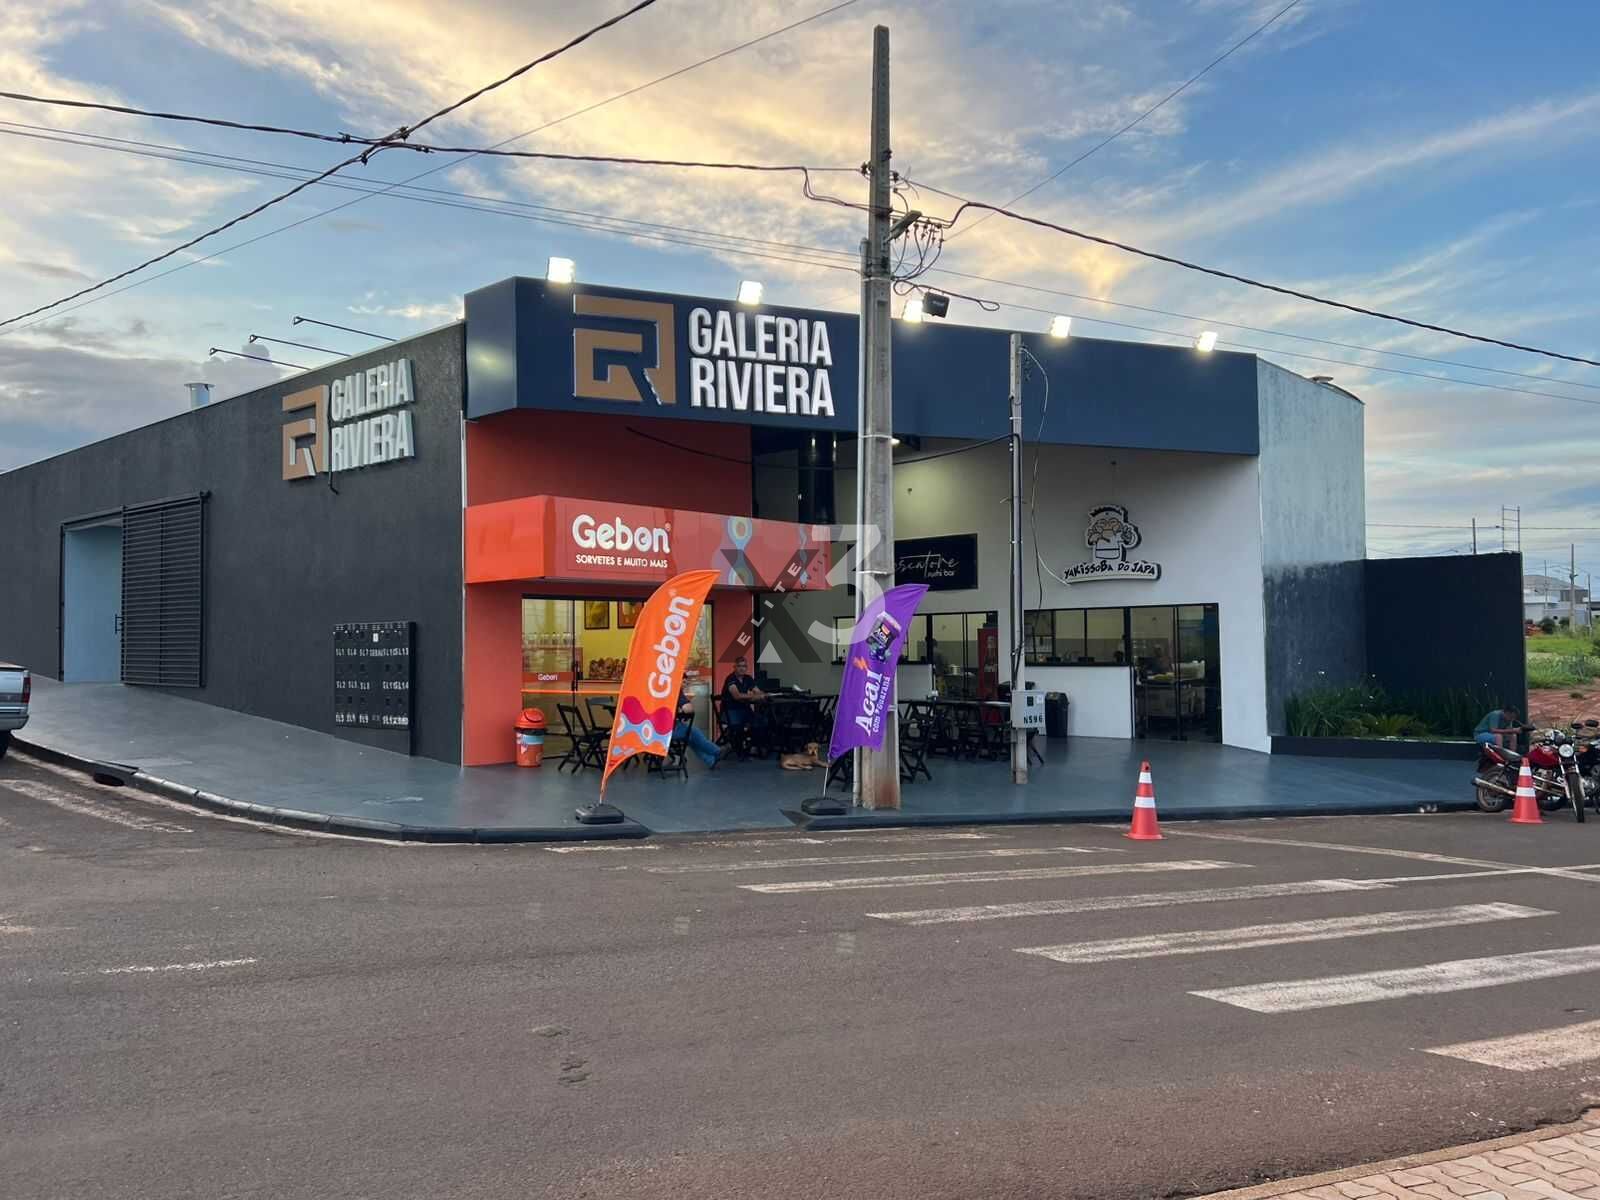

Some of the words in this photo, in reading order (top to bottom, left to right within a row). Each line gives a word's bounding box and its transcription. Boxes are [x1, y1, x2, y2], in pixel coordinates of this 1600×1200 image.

[689, 307, 832, 366] GALERIA
[331, 358, 414, 422] GALERIA
[690, 357, 835, 417] RIVIERA
[331, 410, 415, 472] RIVIERA
[572, 514, 671, 554] Gebon
[575, 554, 616, 566] SORVETES
[616, 556, 623, 566] E
[623, 557, 649, 568] MUITO
[649, 559, 669, 569] MAIS
[1063, 559, 1114, 580] YAKISSOBA
[1117, 560, 1130, 572] DO
[1131, 560, 1156, 575] JAPA
[647, 594, 696, 699] Gebon
